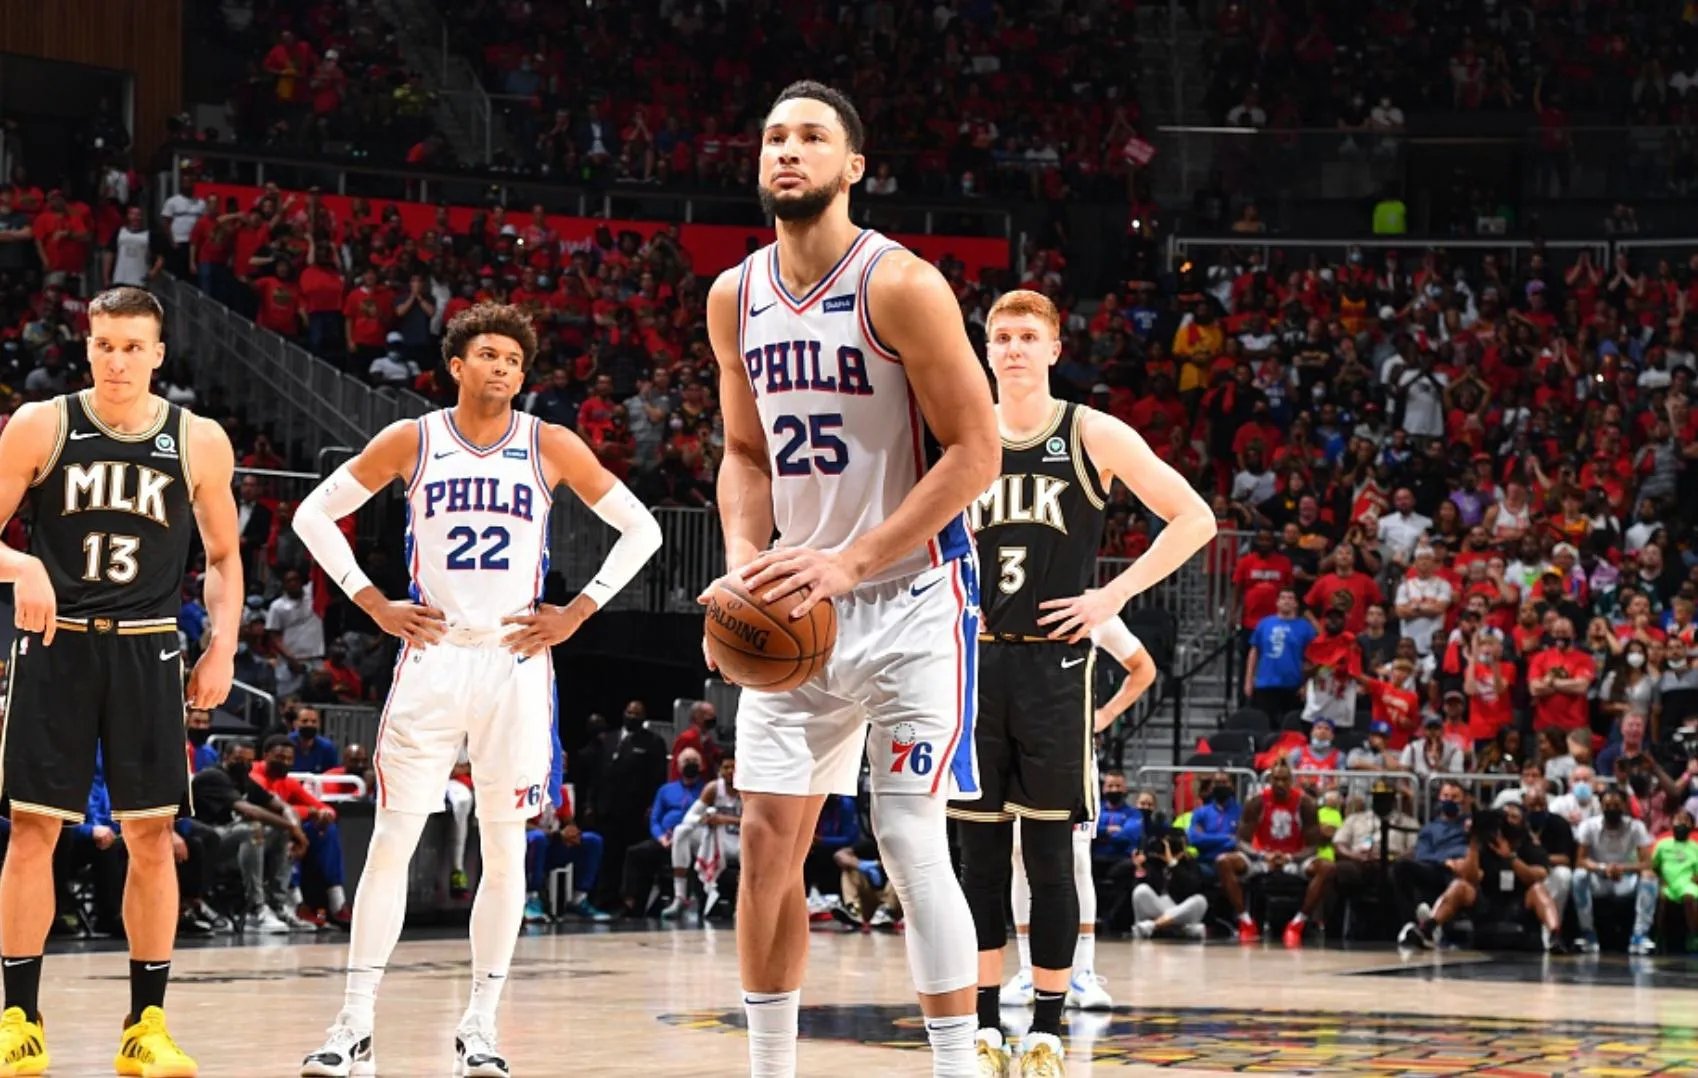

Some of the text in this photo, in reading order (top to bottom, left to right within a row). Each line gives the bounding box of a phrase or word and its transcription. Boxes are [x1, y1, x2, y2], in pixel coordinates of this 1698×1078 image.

[745, 340, 874, 398] PHILA
[773, 413, 850, 476] 25
[61, 461, 175, 528] MLK
[424, 476, 534, 522] PHILA
[970, 474, 1070, 535] MLK
[82, 532, 141, 584] 13
[446, 526, 511, 570] 22
[998, 546, 1027, 594] 3
[706, 596, 769, 652] PALDING
[890, 738, 933, 776] 76
[514, 784, 541, 809] 76
